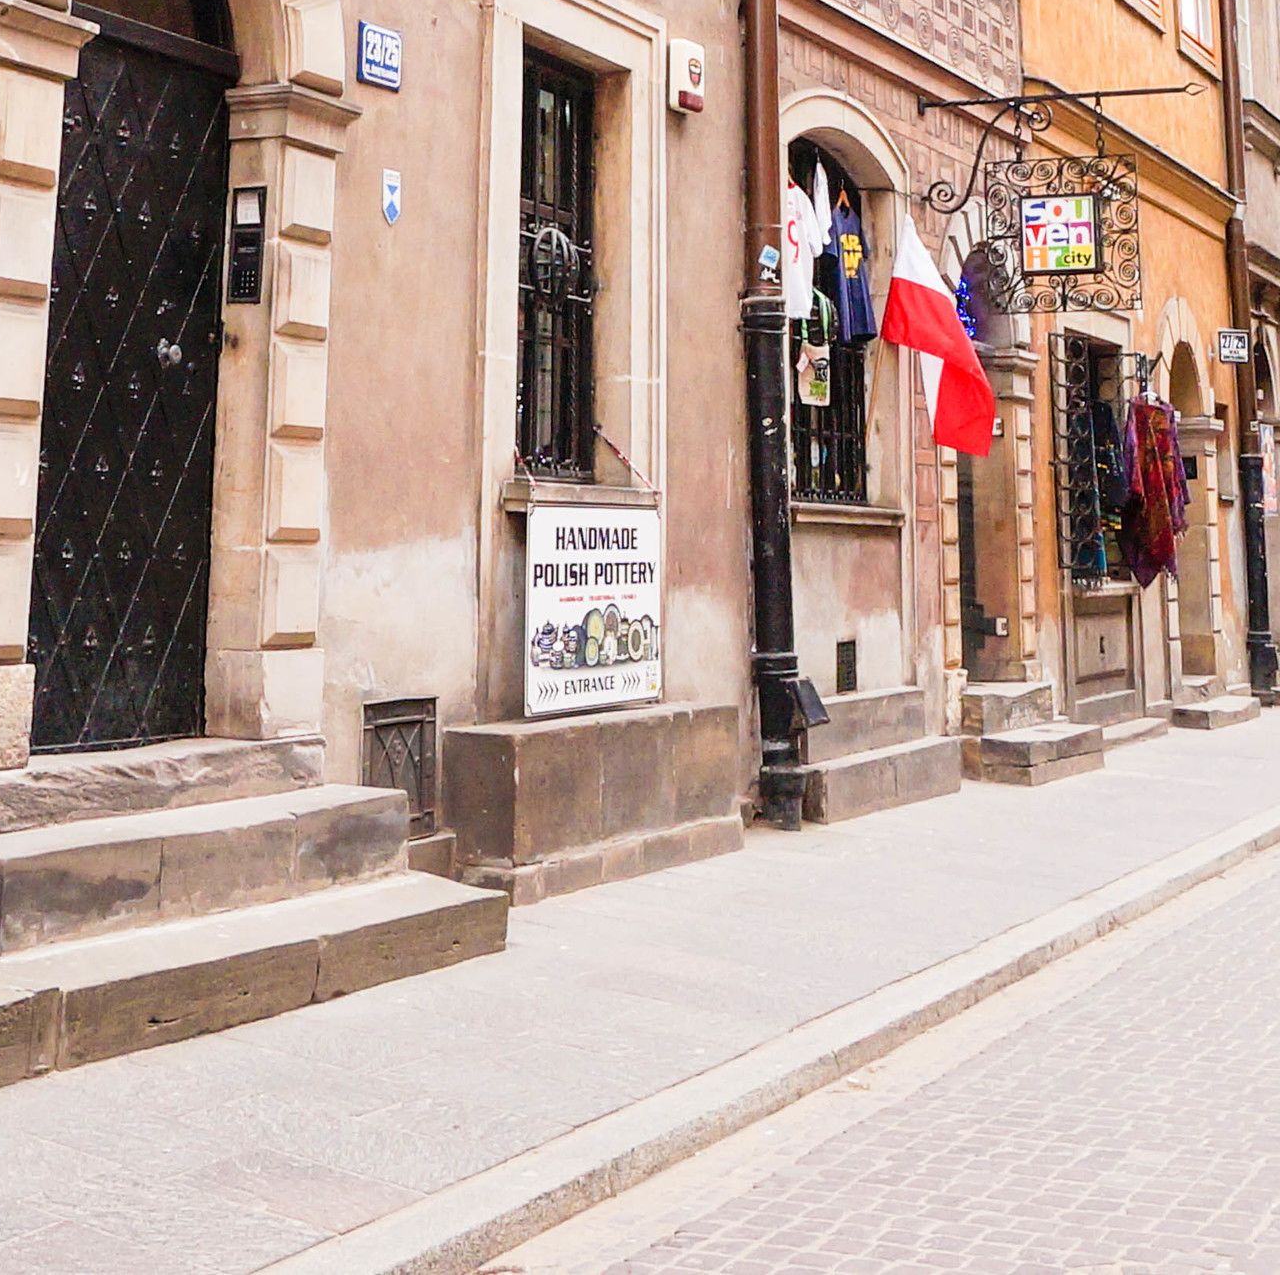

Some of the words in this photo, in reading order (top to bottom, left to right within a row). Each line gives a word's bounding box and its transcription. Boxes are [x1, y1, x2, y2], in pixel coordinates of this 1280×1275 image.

[366, 31, 400, 68] 23/25
[1064, 252, 1092, 266] city
[555, 527, 638, 550] HANDMADE
[533, 562, 588, 587] POLISH
[595, 562, 656, 585] POTTERY
[564, 675, 616, 695] ENTRANCE
